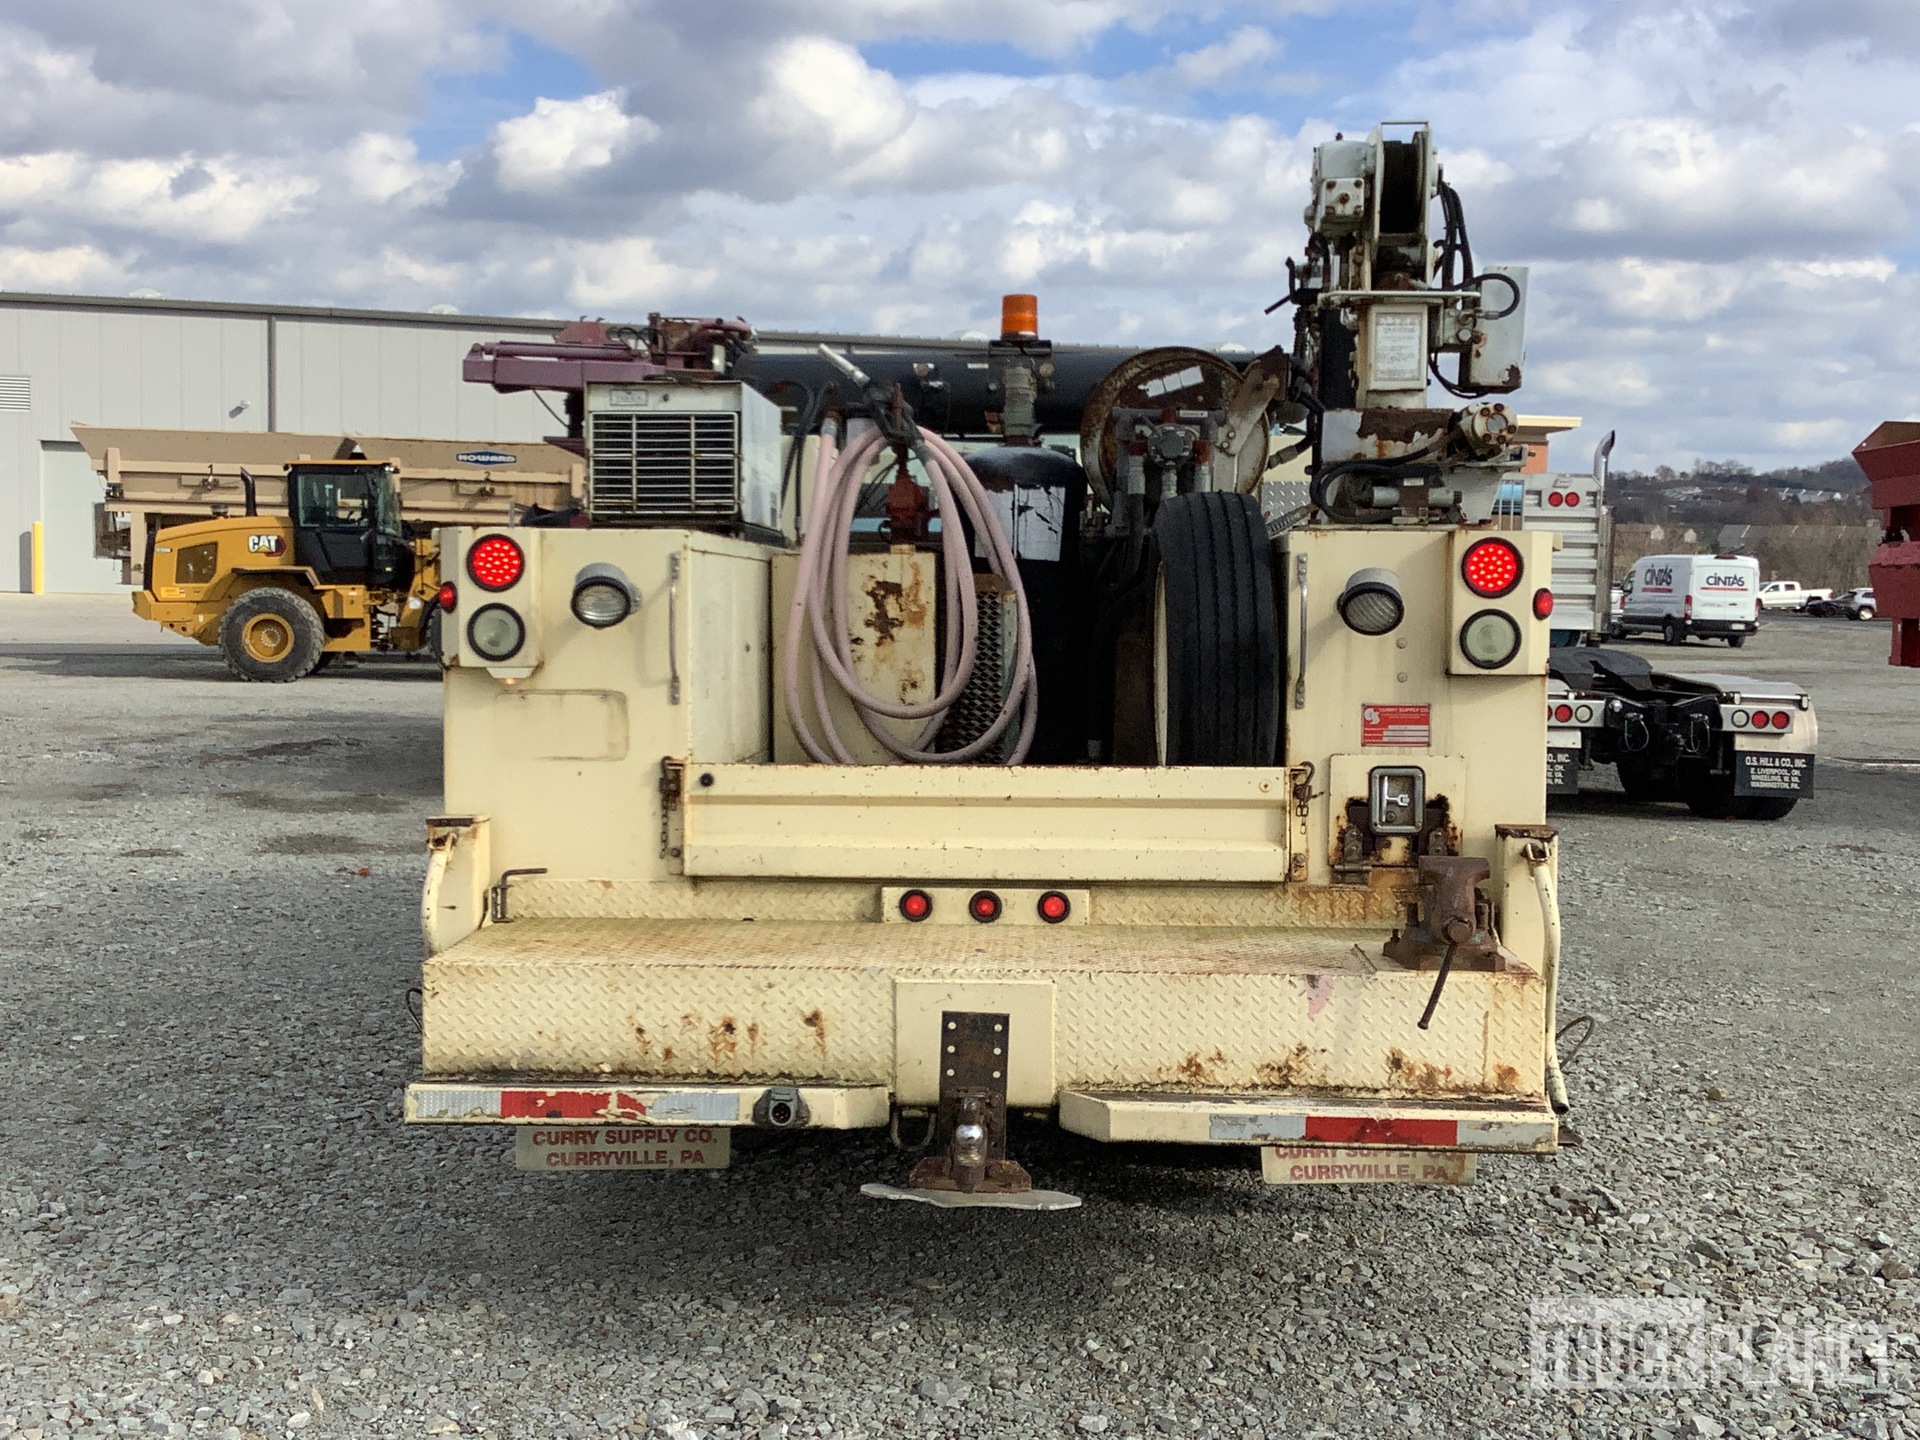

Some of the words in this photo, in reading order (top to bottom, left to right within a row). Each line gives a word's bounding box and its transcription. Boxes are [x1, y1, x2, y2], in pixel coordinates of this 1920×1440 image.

[458, 454, 516, 463] HOWARD
[248, 535, 278, 553] CAT
[1760, 756, 1774, 767] HILL
[532, 1130, 598, 1146] CURRY
[604, 1128, 678, 1144] SUPPLY
[684, 1128, 718, 1144] CO.
[546, 1150, 674, 1168] CURRYVILLE,
[680, 1149, 705, 1164] PA
[1290, 1164, 1416, 1182] CURRYVILLE,
